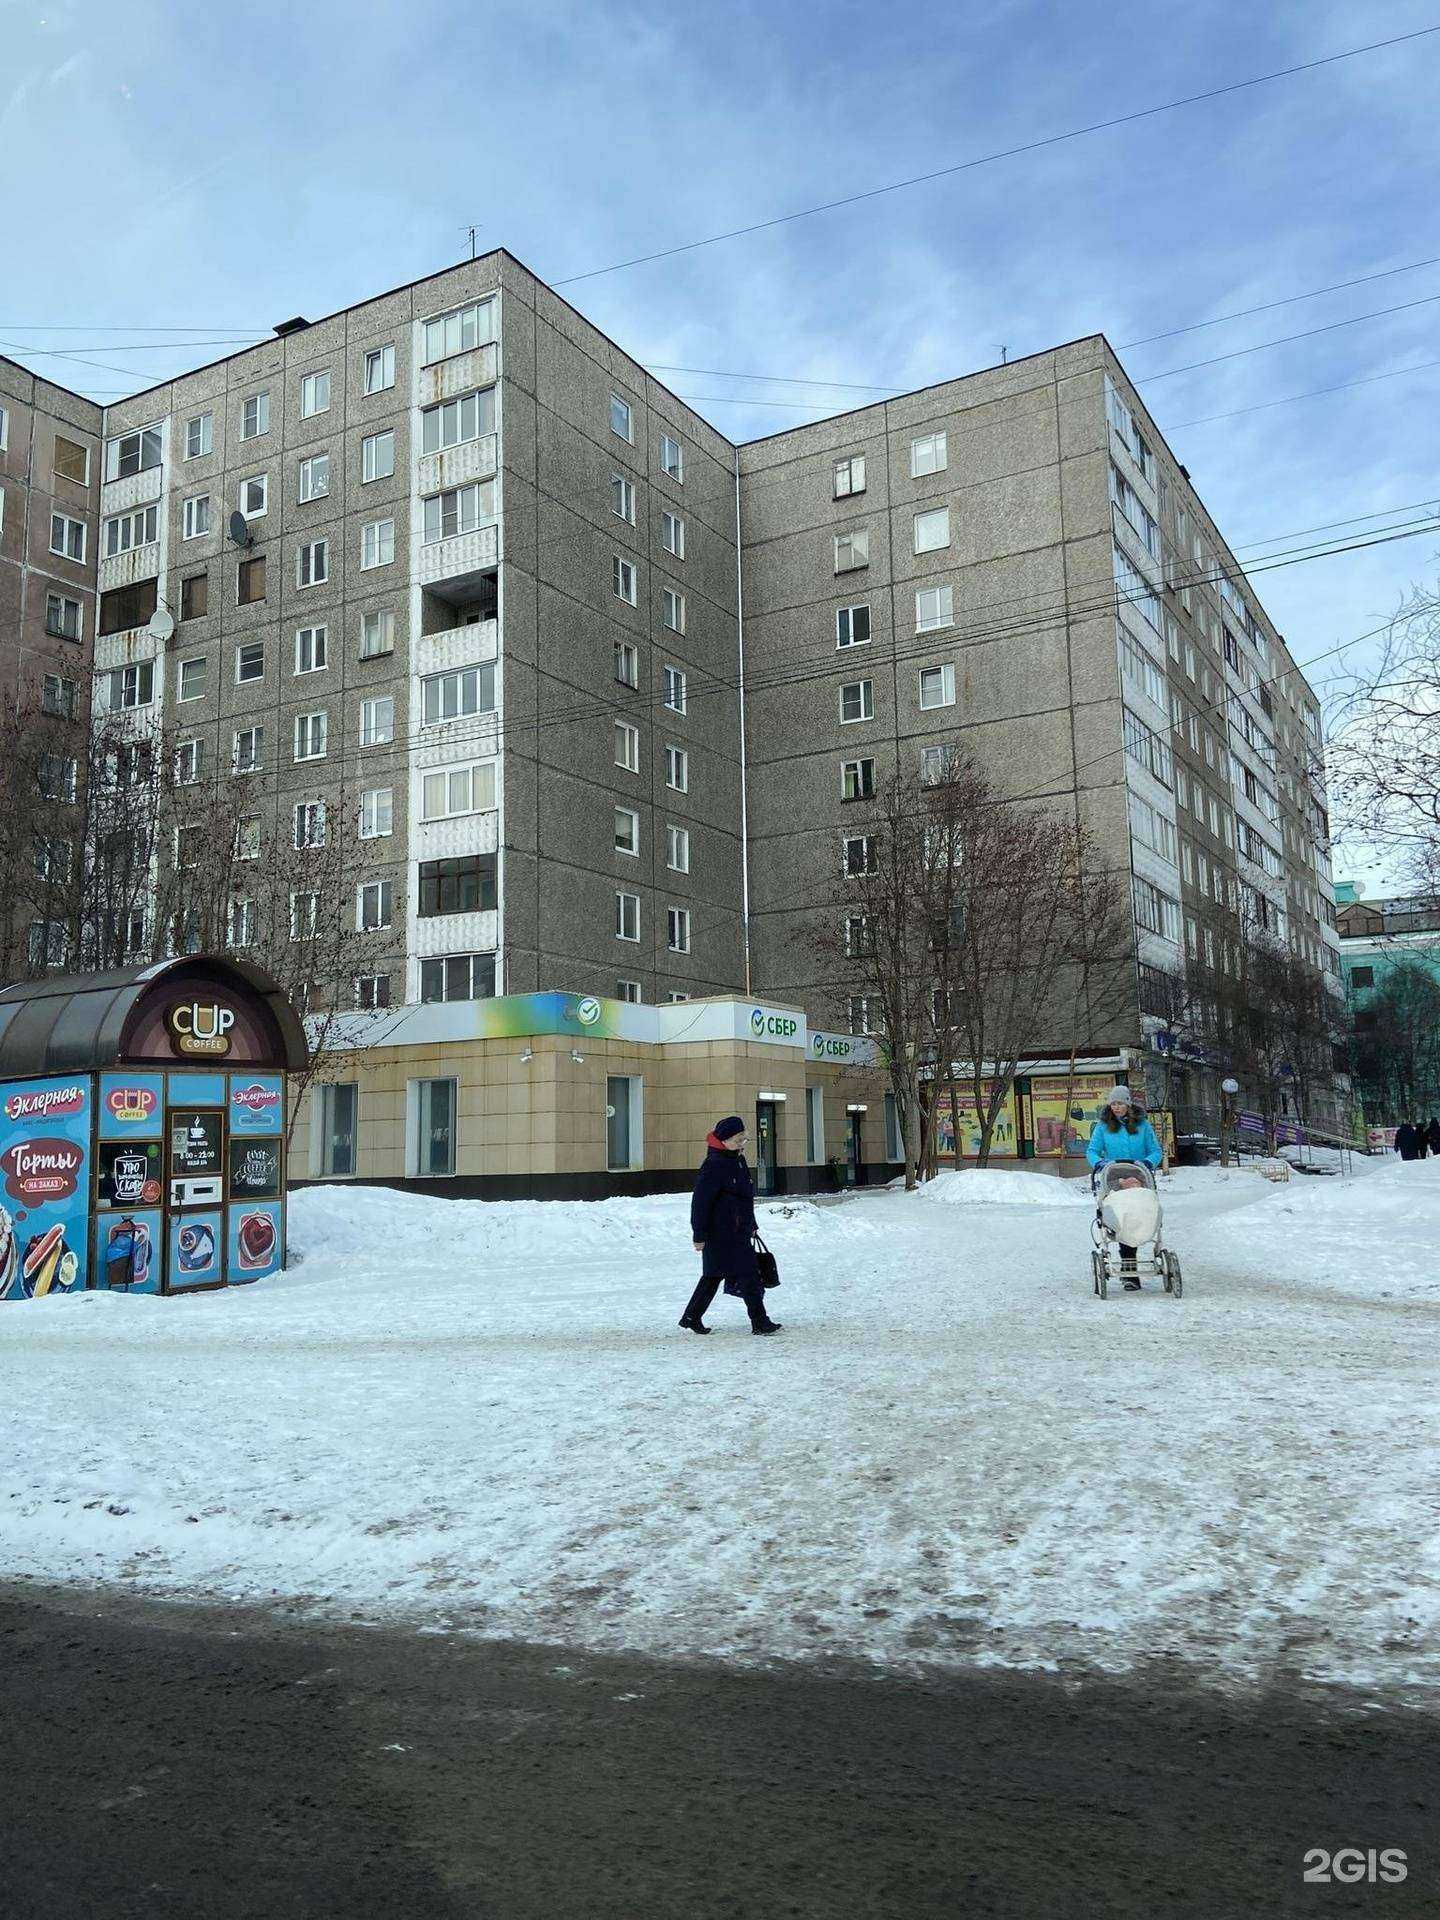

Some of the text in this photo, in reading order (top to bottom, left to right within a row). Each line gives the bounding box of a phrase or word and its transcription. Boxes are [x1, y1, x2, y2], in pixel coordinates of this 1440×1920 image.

[173, 1002, 235, 1039] CUP
[767, 1016, 797, 1037] СБЕР
[186, 1039, 222, 1049] COFFEE
[826, 1039, 850, 1056] СБЕР
[10, 1086, 78, 1120] Эклерная
[110, 1089, 152, 1110] CUP
[235, 1091, 277, 1104] Эклерная
[11, 1144, 77, 1177] Торты
[39, 1180, 59, 1189] ЗАКАЗ
